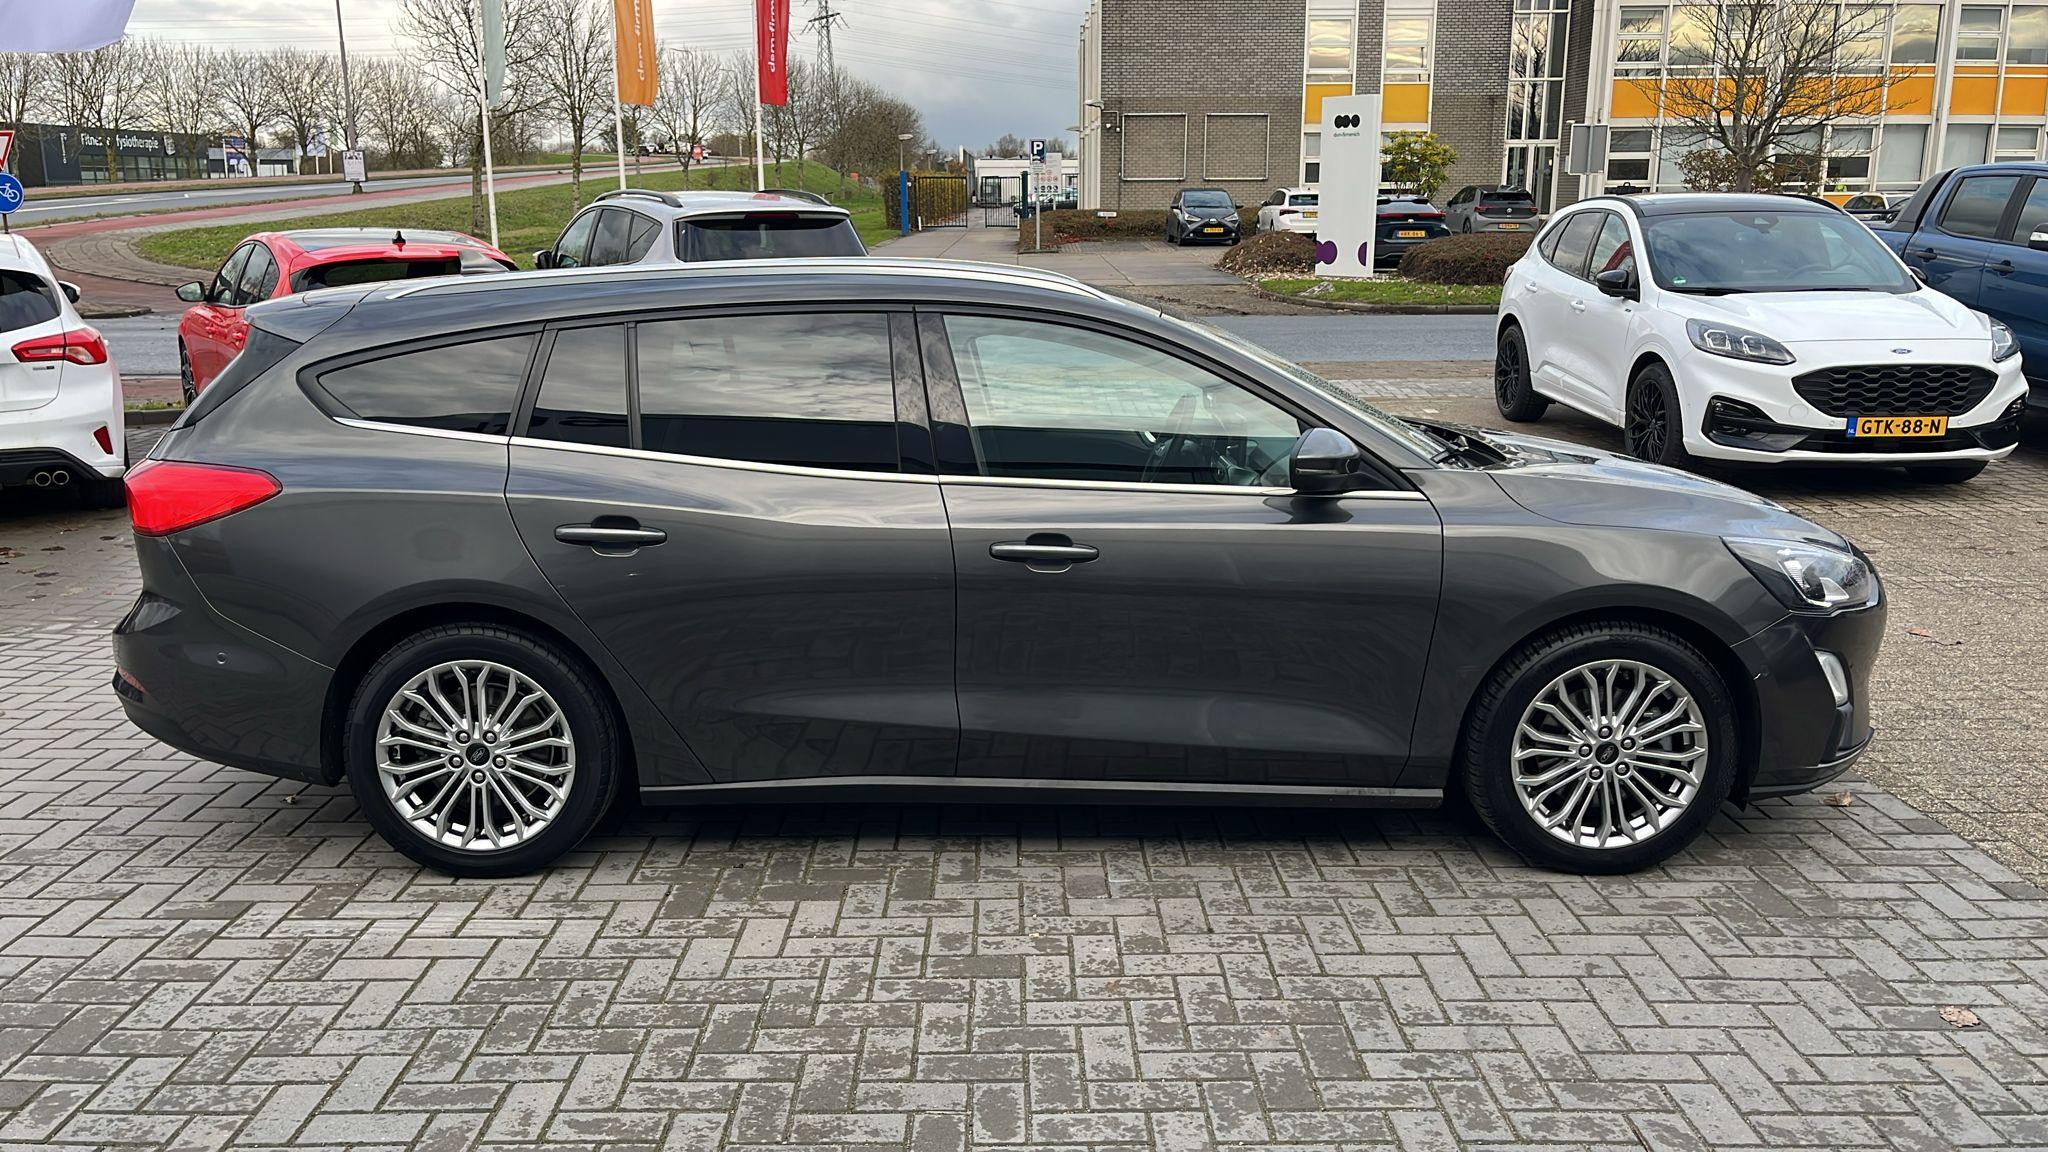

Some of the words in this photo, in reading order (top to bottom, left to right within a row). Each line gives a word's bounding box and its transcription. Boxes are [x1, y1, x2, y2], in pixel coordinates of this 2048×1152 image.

[633, 0, 646, 81] dsmfirm
[115, 134, 159, 151] fysiotherapie
[1033, 141, 1043, 155] P
[1861, 420, 1941, 434] GTK-88-N
